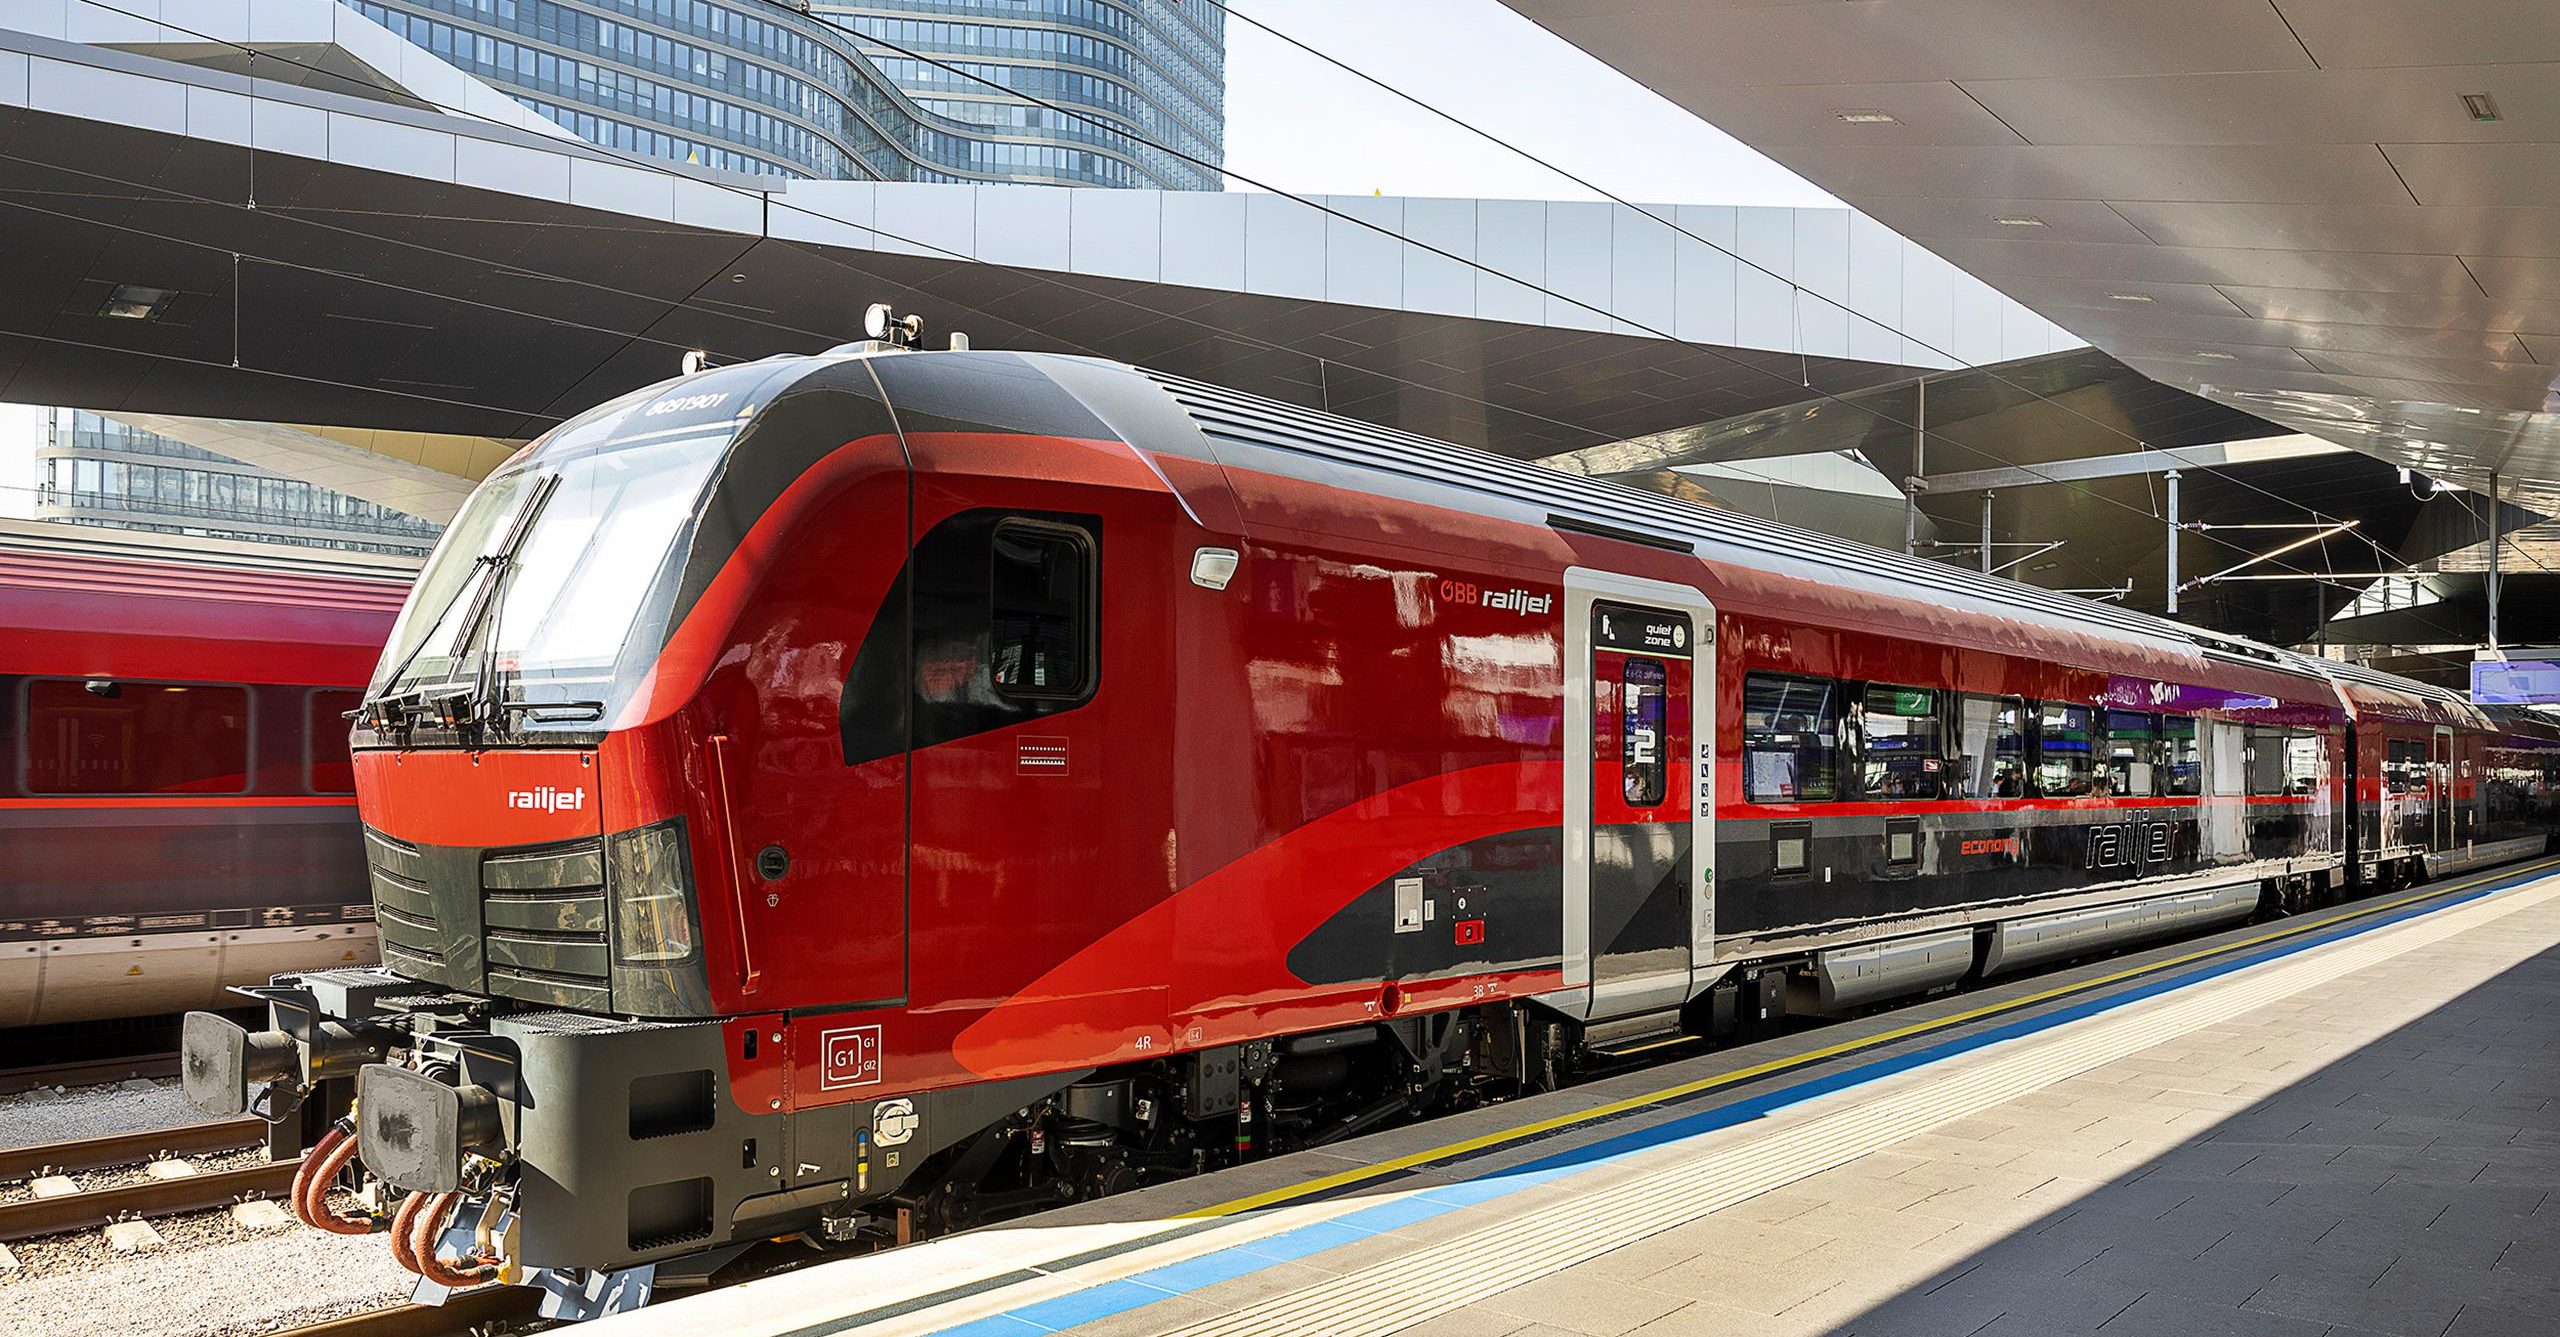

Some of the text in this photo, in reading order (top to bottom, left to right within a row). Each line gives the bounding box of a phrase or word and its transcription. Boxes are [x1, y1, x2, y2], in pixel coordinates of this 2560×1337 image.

[1440, 579, 1553, 617] ÖBB railjet
[1646, 623, 1672, 637] quiet
[1644, 635, 1671, 647] zone
[1634, 729, 1655, 764] 2
[508, 785, 586, 814] railjet
[1961, 837, 2019, 857] economy
[2086, 808, 2180, 878] railjet
[1473, 984, 1484, 998] 3R
[864, 1036, 875, 1049] G1
[1134, 1035, 1152, 1050] 4R
[835, 1049, 855, 1068] G1
